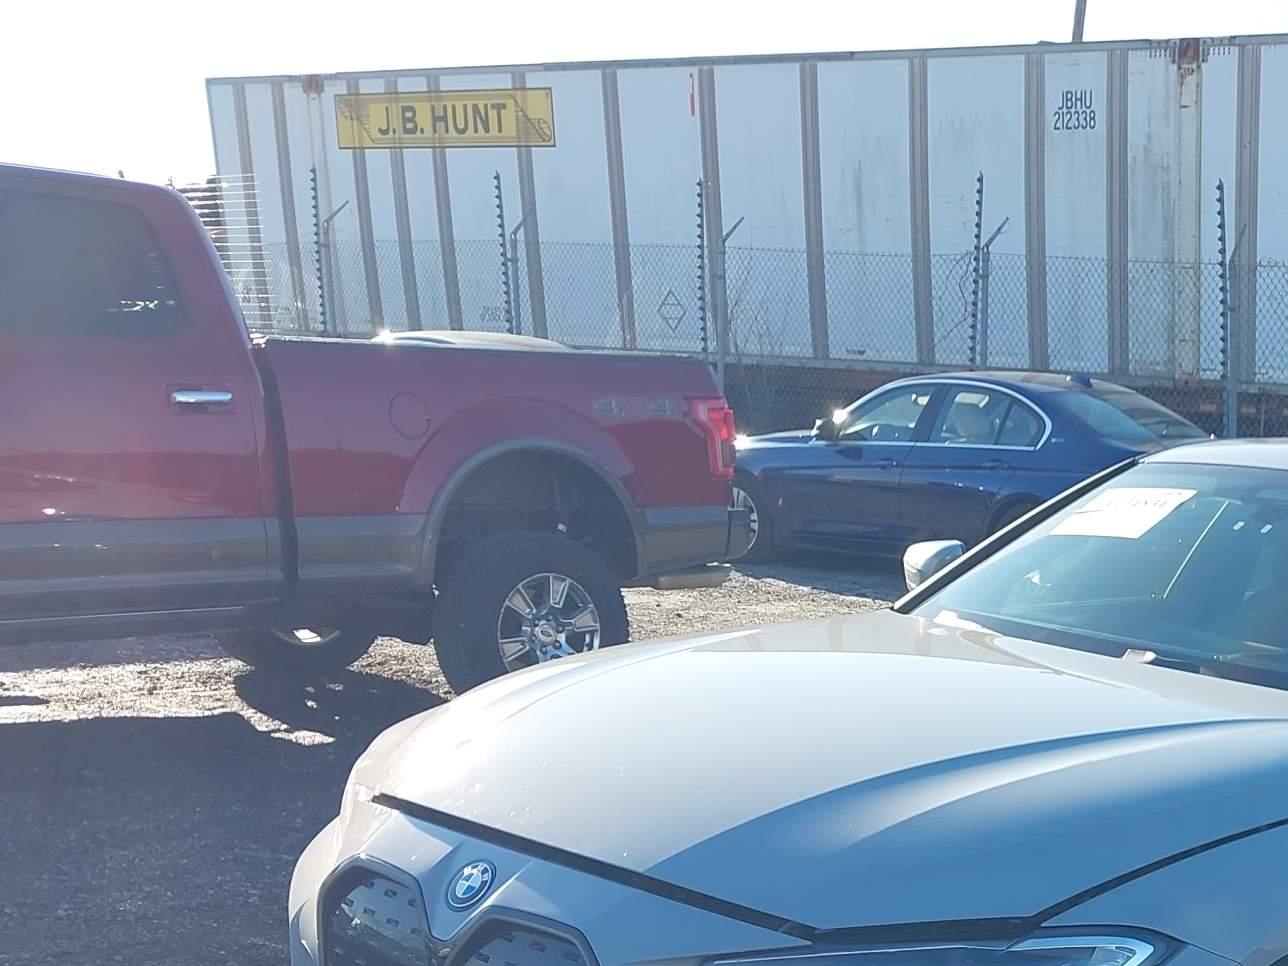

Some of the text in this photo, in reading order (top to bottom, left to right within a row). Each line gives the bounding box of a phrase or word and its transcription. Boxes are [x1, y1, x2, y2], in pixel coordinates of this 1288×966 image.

[1057, 90, 1093, 110] JBHU
[430, 103, 508, 135] HUNT
[1053, 110, 1097, 130] 212338
